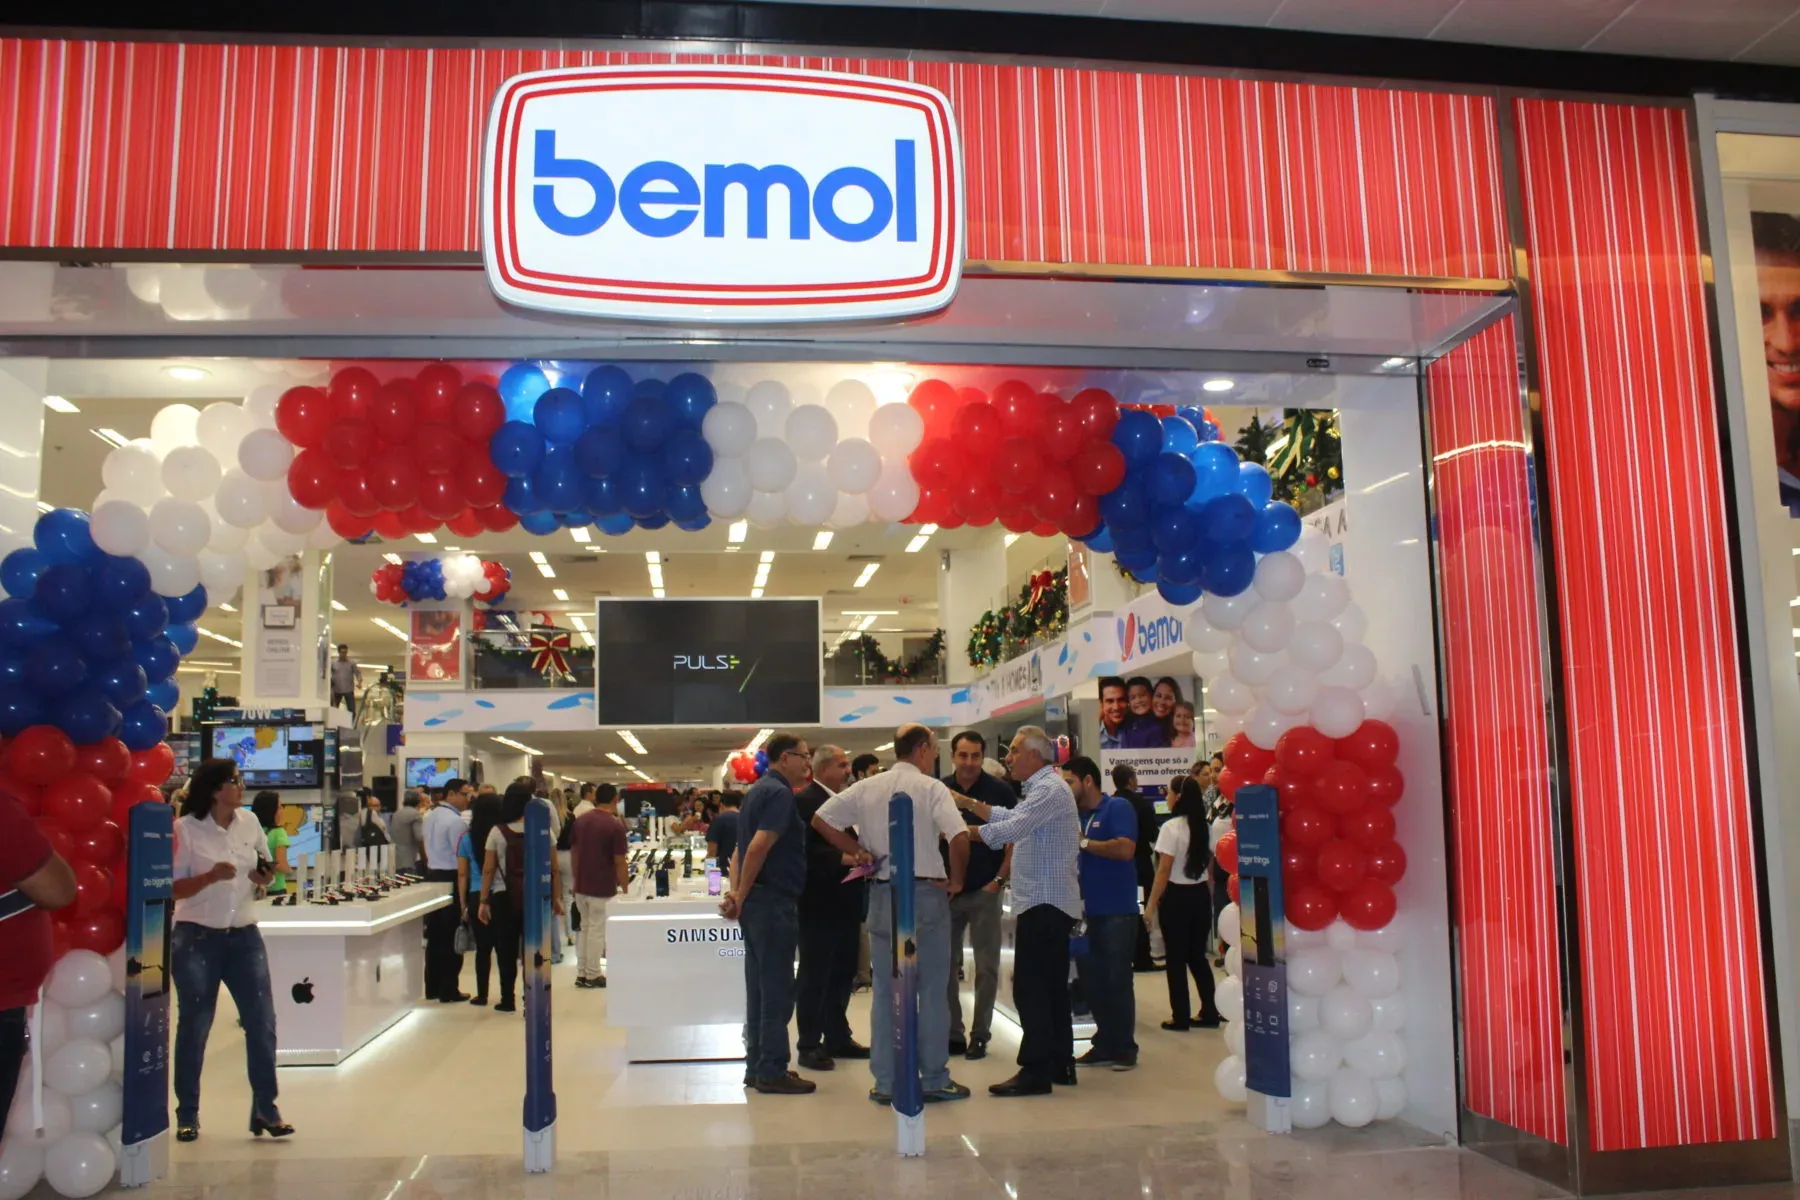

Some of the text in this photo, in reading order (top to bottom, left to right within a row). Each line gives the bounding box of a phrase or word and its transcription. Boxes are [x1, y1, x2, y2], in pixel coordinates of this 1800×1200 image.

[533, 129, 917, 242] bemol
[1109, 758, 1154, 766] Vantagens
[1155, 758, 1171, 766] que
[667, 928, 744, 943] SAMSUN
[718, 948, 745, 957] Gala
